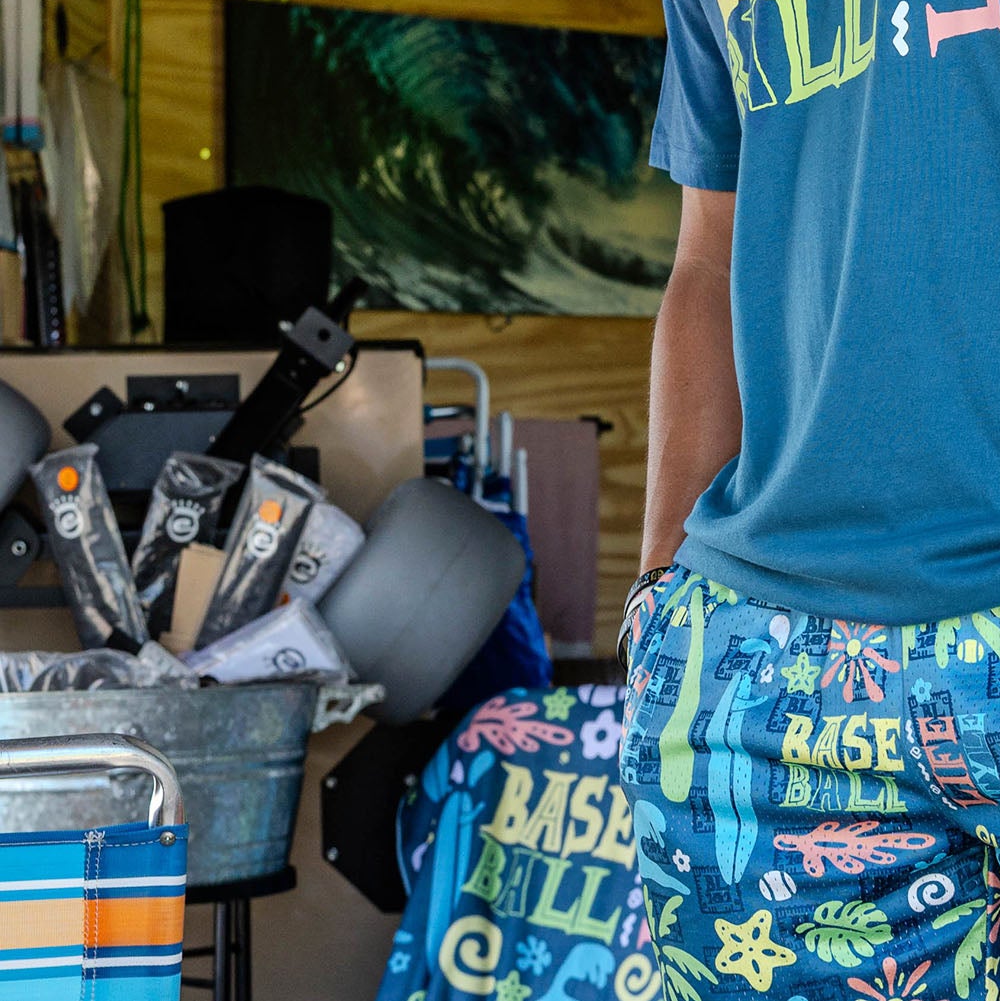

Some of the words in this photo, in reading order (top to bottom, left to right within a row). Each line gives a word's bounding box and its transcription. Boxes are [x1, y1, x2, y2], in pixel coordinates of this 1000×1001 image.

[780, 711, 905, 773] BASE
[479, 760, 637, 872] BASE
[781, 762, 908, 815] BALL
[460, 832, 624, 946] BALL
